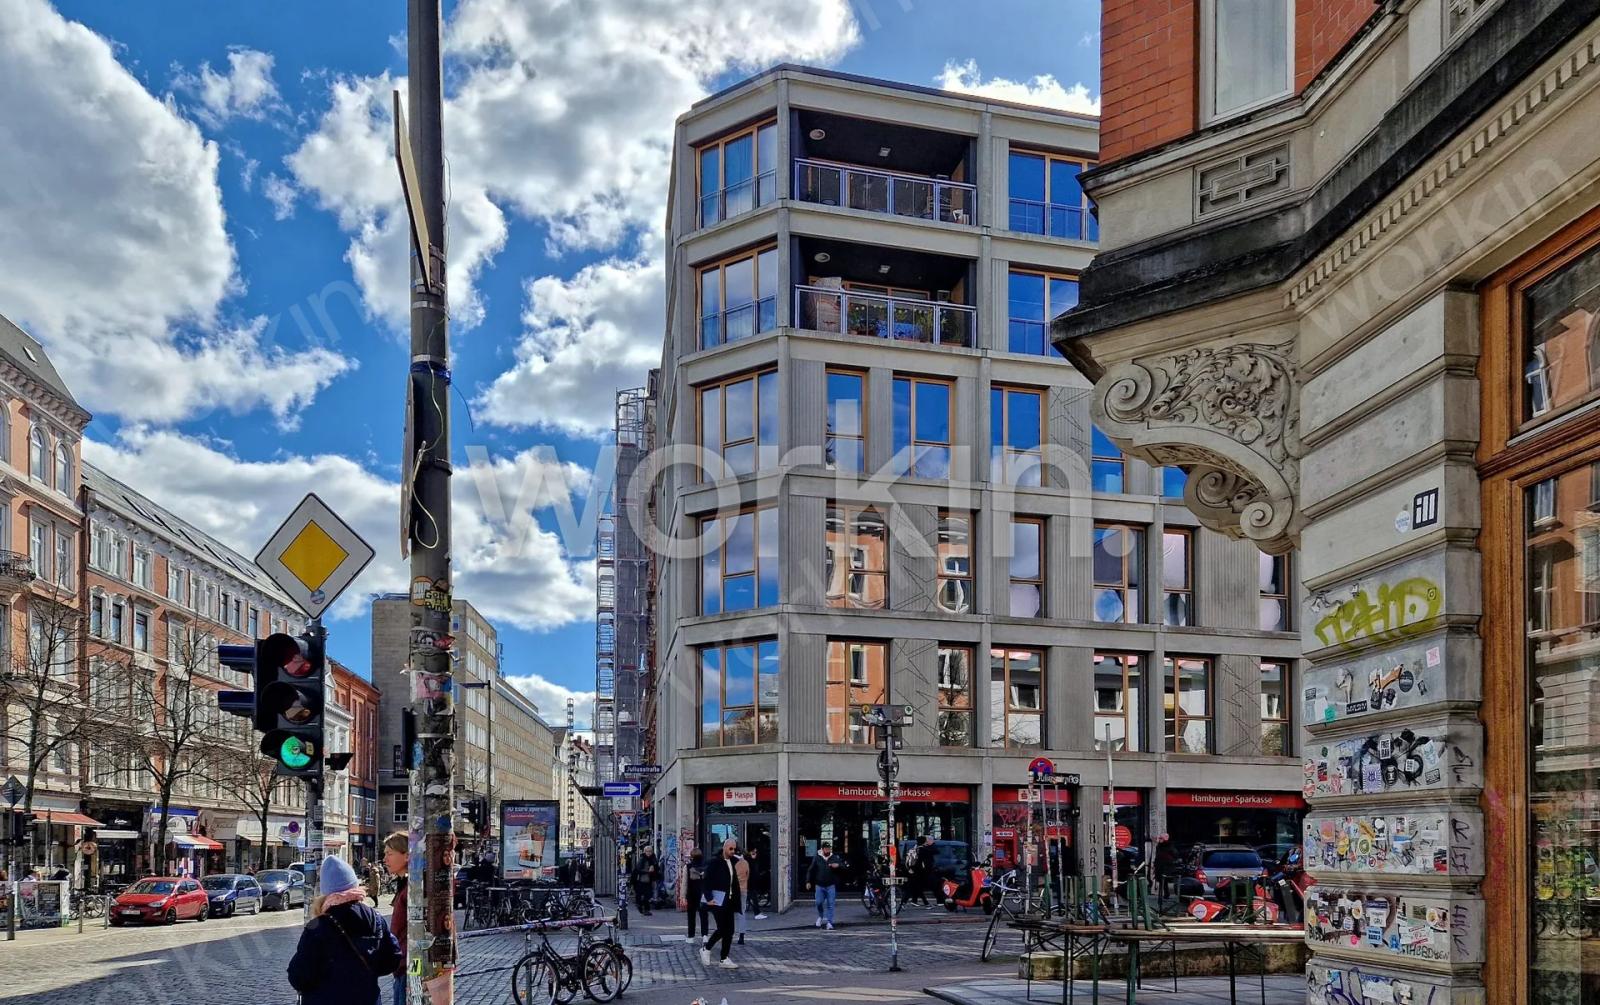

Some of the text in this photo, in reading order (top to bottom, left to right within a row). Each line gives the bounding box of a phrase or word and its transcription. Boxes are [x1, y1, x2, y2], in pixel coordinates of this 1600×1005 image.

[734, 791, 754, 800] Haspa
[838, 786, 885, 797] Hamburg
[1191, 793, 1273, 804] Hamburger Sparkasse
